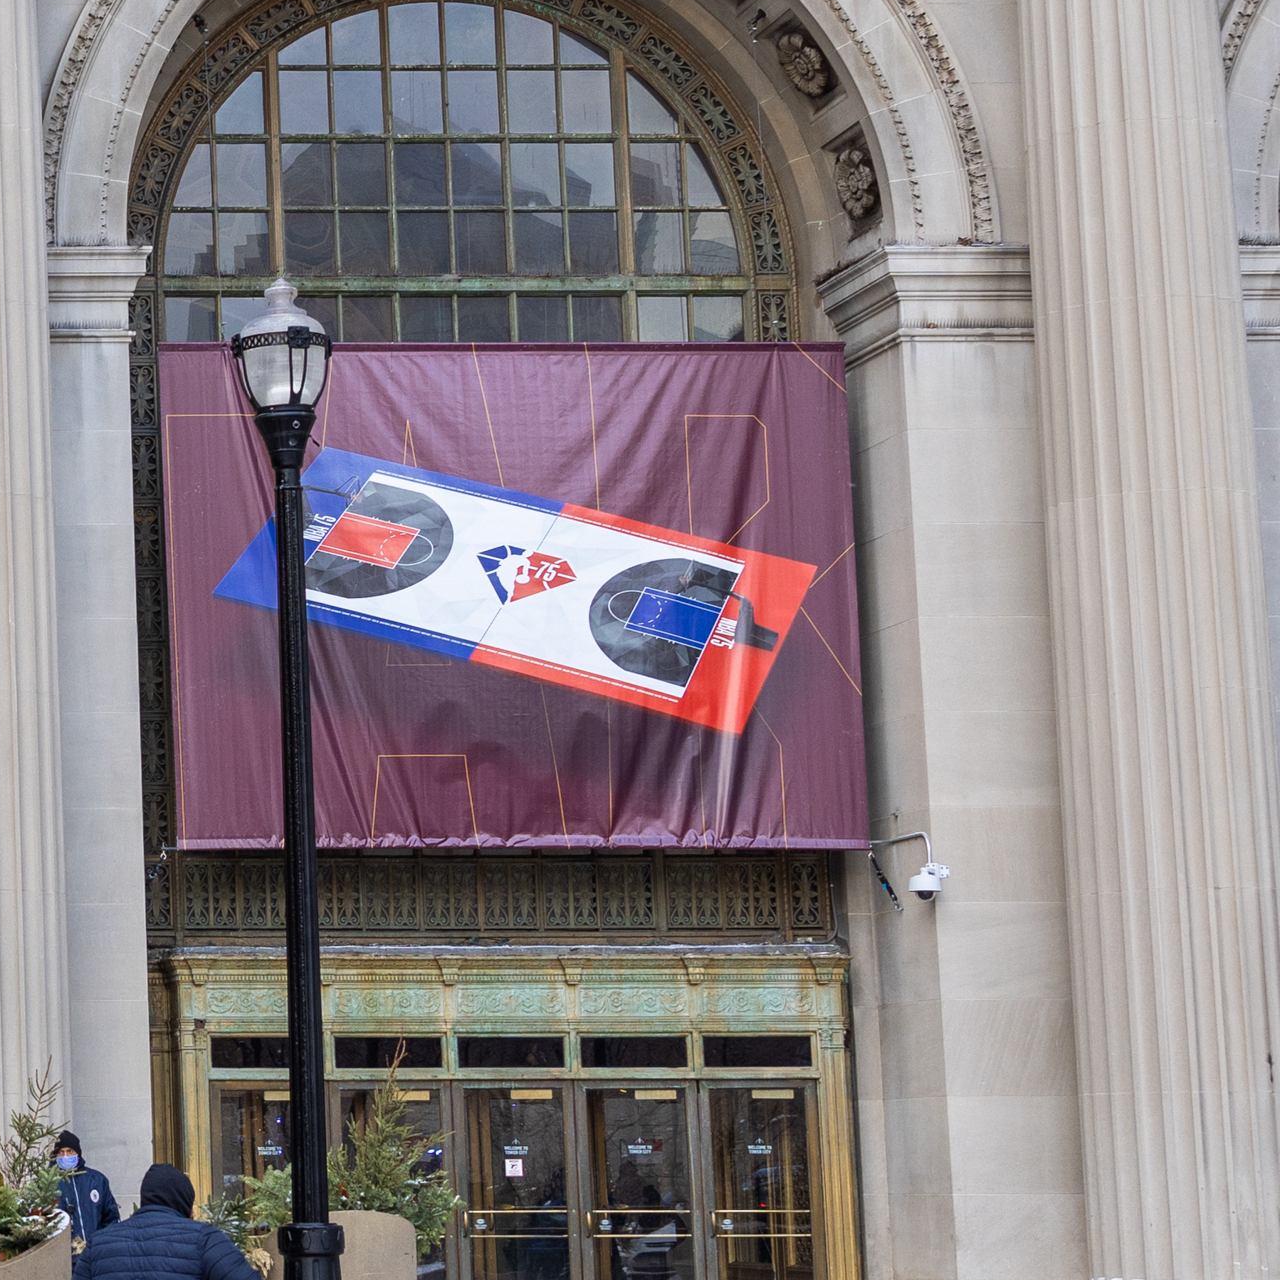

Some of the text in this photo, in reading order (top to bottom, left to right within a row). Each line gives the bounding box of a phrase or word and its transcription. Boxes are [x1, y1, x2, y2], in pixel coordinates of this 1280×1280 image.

[303, 513, 337, 542] NBA 75
[534, 561, 561, 582] 75
[710, 634, 735, 650] 75
